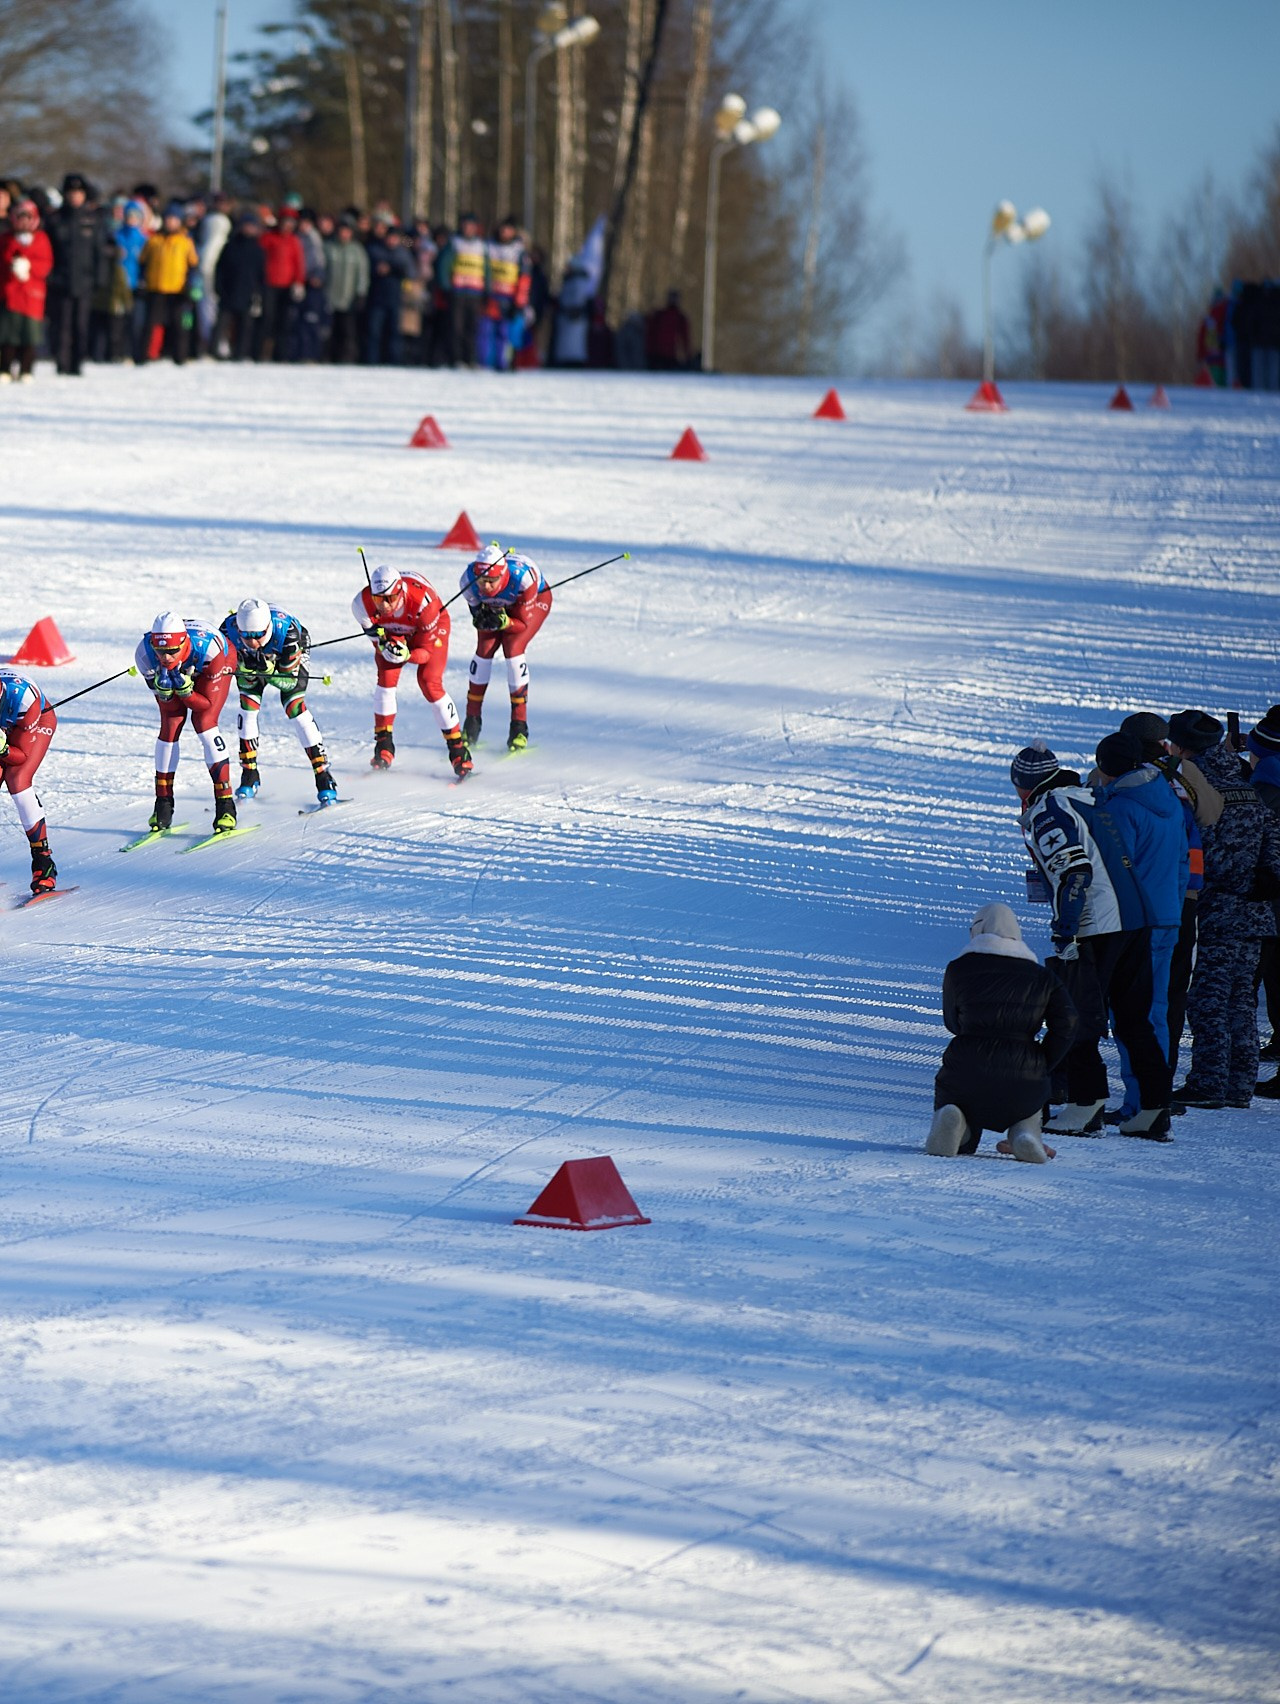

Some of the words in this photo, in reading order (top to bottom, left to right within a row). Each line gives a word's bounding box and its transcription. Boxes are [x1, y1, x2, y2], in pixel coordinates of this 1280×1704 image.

[469, 660, 477, 675] 0
[519, 662, 528, 677] 2
[447, 702, 456, 718] 2
[213, 735, 226, 752] 9
